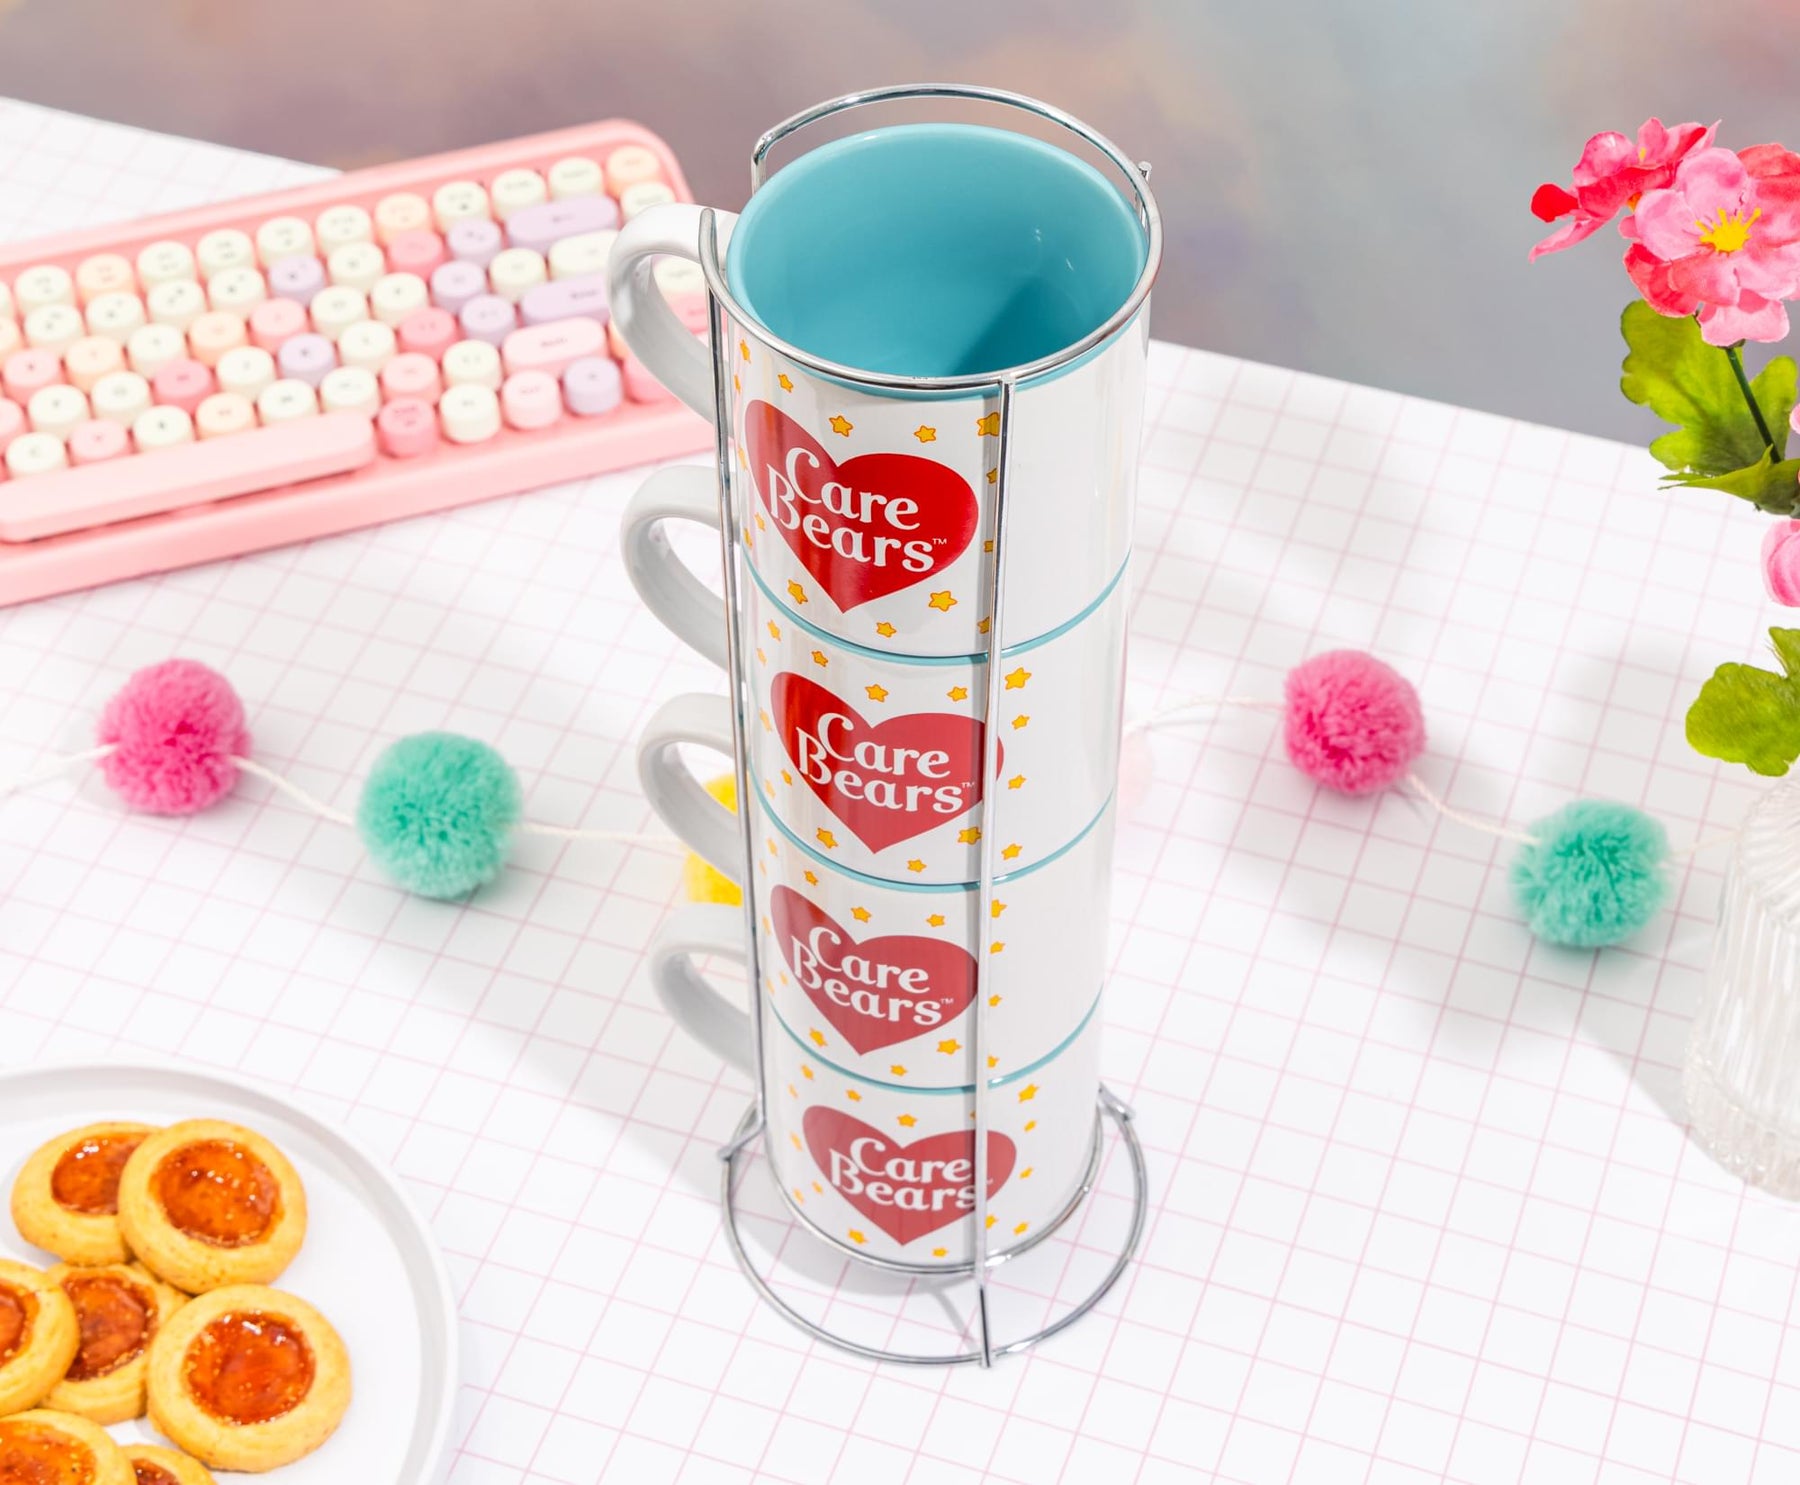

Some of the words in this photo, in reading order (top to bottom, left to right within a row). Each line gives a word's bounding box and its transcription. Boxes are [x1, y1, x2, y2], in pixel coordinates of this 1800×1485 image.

[767, 463, 935, 573] Bears
[785, 447, 921, 530] Care
[795, 726, 963, 814] Bears
[817, 712, 951, 779] Care
[790, 935, 943, 1026] Bears
[809, 926, 931, 994] Care
[829, 1147, 977, 1212] Bears
[850, 1137, 973, 1184] Care
